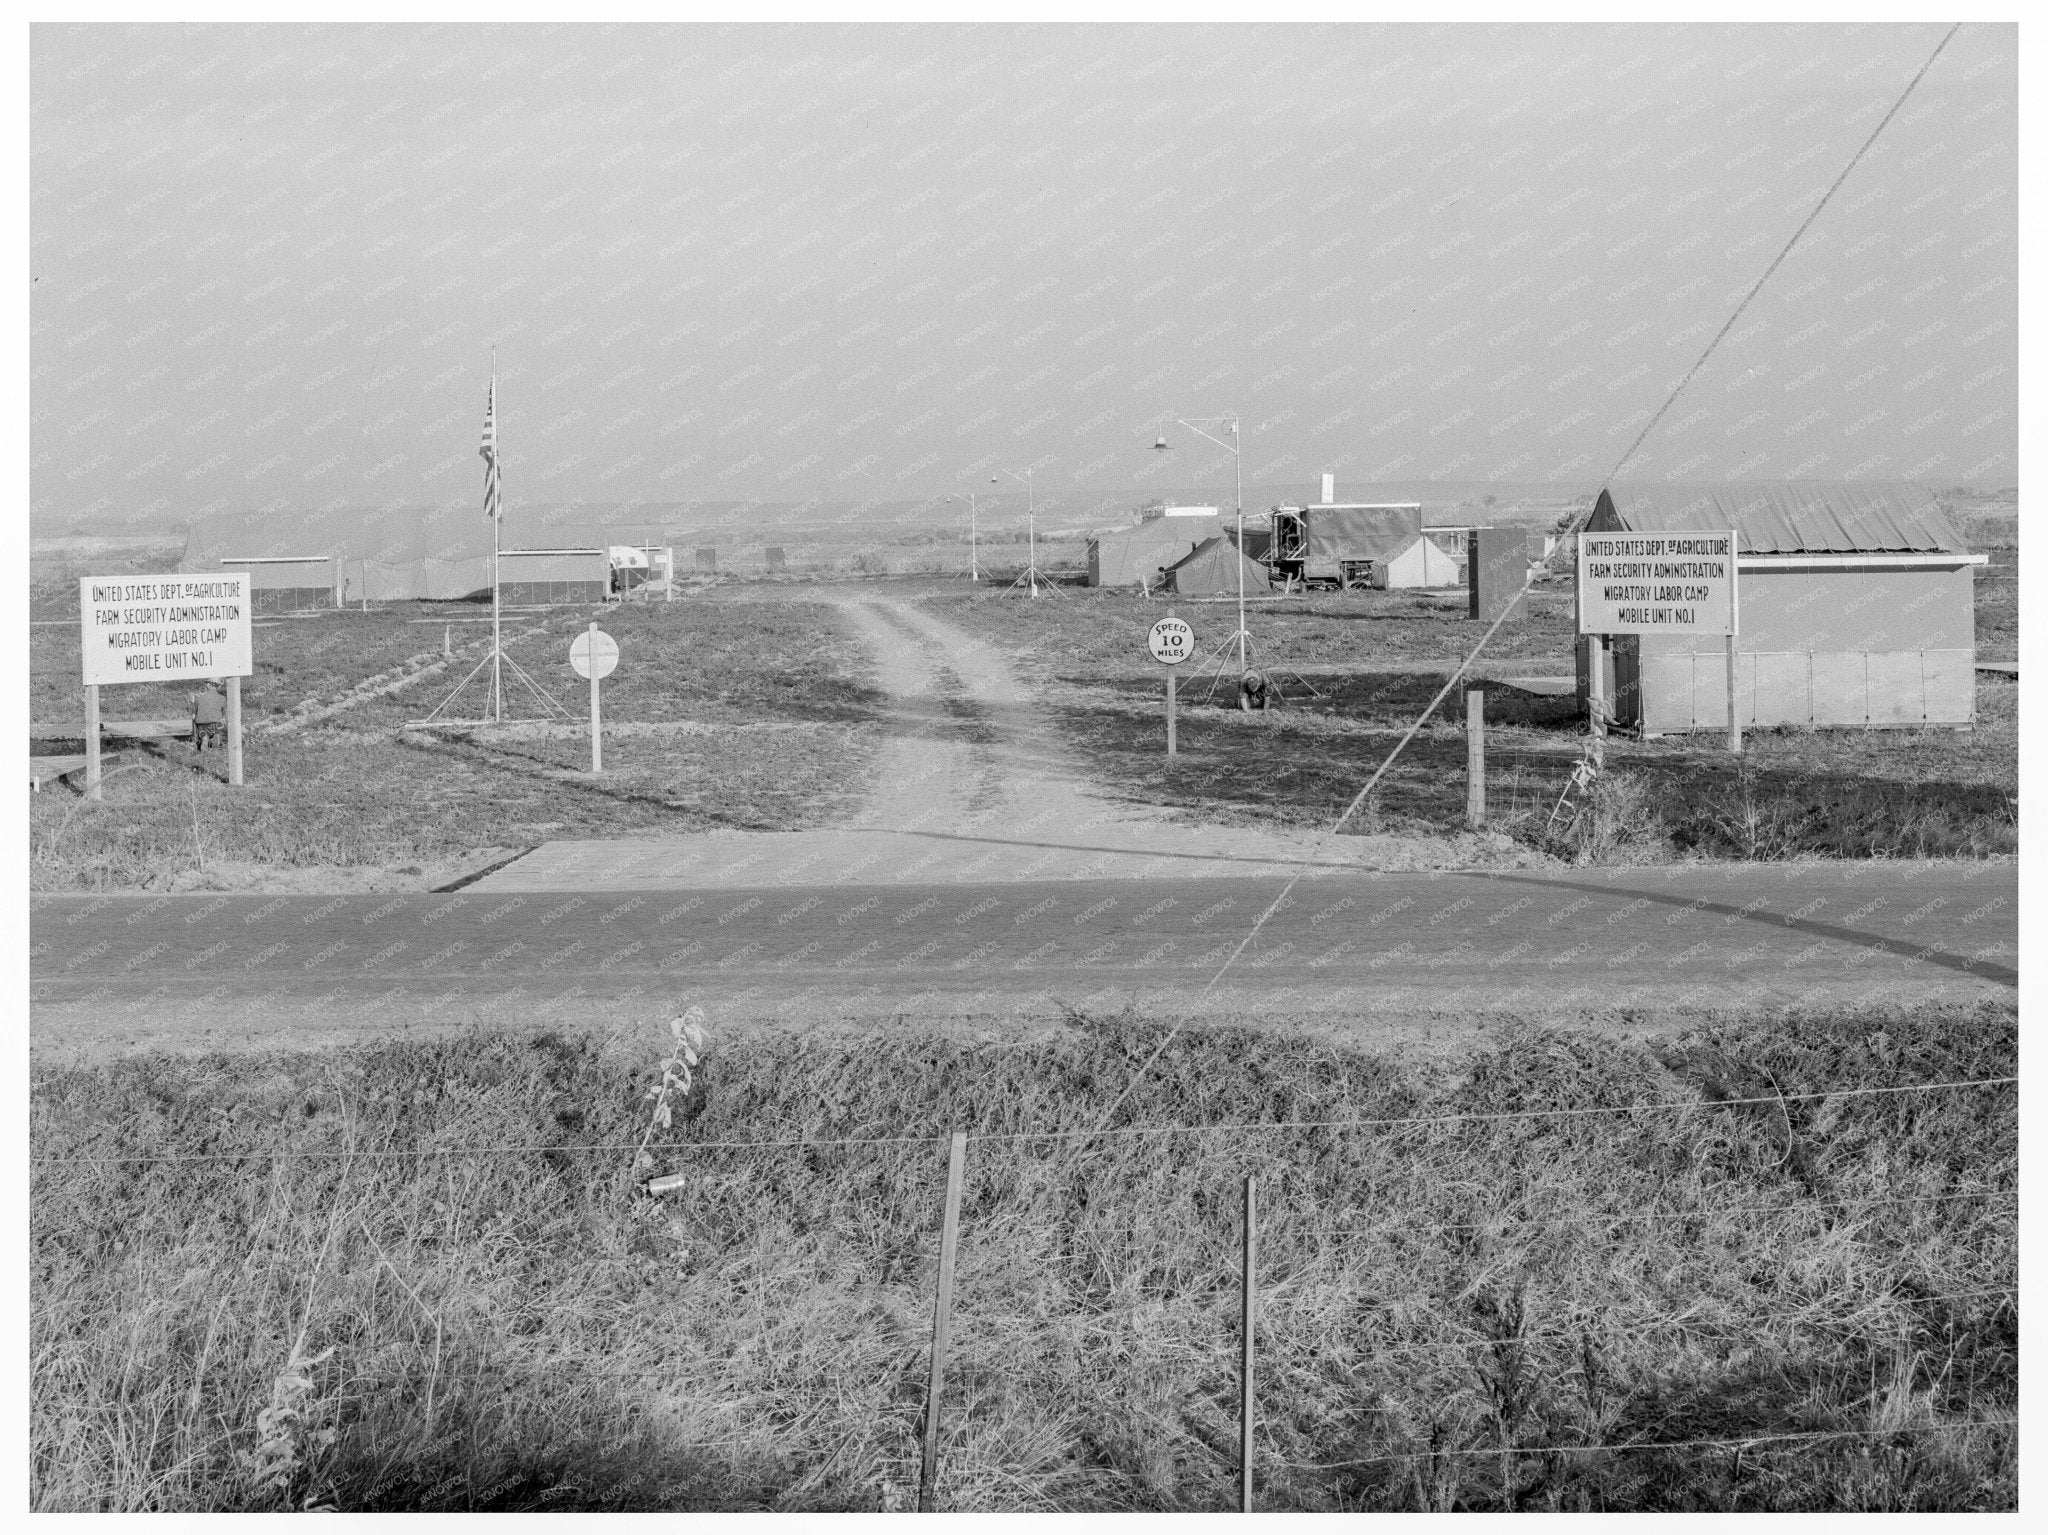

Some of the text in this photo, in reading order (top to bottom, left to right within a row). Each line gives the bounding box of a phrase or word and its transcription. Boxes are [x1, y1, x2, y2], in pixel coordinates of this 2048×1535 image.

[1586, 541, 1613, 556] UNITED
[1615, 540, 1644, 556] STATES
[1646, 540, 1668, 556] DEPT.
[1676, 540, 1728, 556] AGRICULTURE
[1590, 562, 1724, 578] FARM SECURITY ADMINISTRATION
[93, 586, 122, 602] UNITED
[125, 585, 158, 601] STATES
[161, 584, 184, 600] DEPT.
[193, 582, 240, 598] AGRICULTURE
[1604, 586, 1709, 601] MIGRATORY LABOR CAMP
[96, 605, 240, 625] FARM SECURITY ADMINISTRATION
[1618, 608, 1650, 623] MOBILE
[1652, 608, 1673, 623] UNIT
[1156, 624, 1187, 635] SPEED
[108, 628, 227, 648] MIGRATORY LABOR CAMP
[1163, 636, 1182, 646] 10
[126, 654, 160, 670] MOBILE
[166, 652, 187, 668] UNIT
[1158, 649, 1184, 657] MILES
